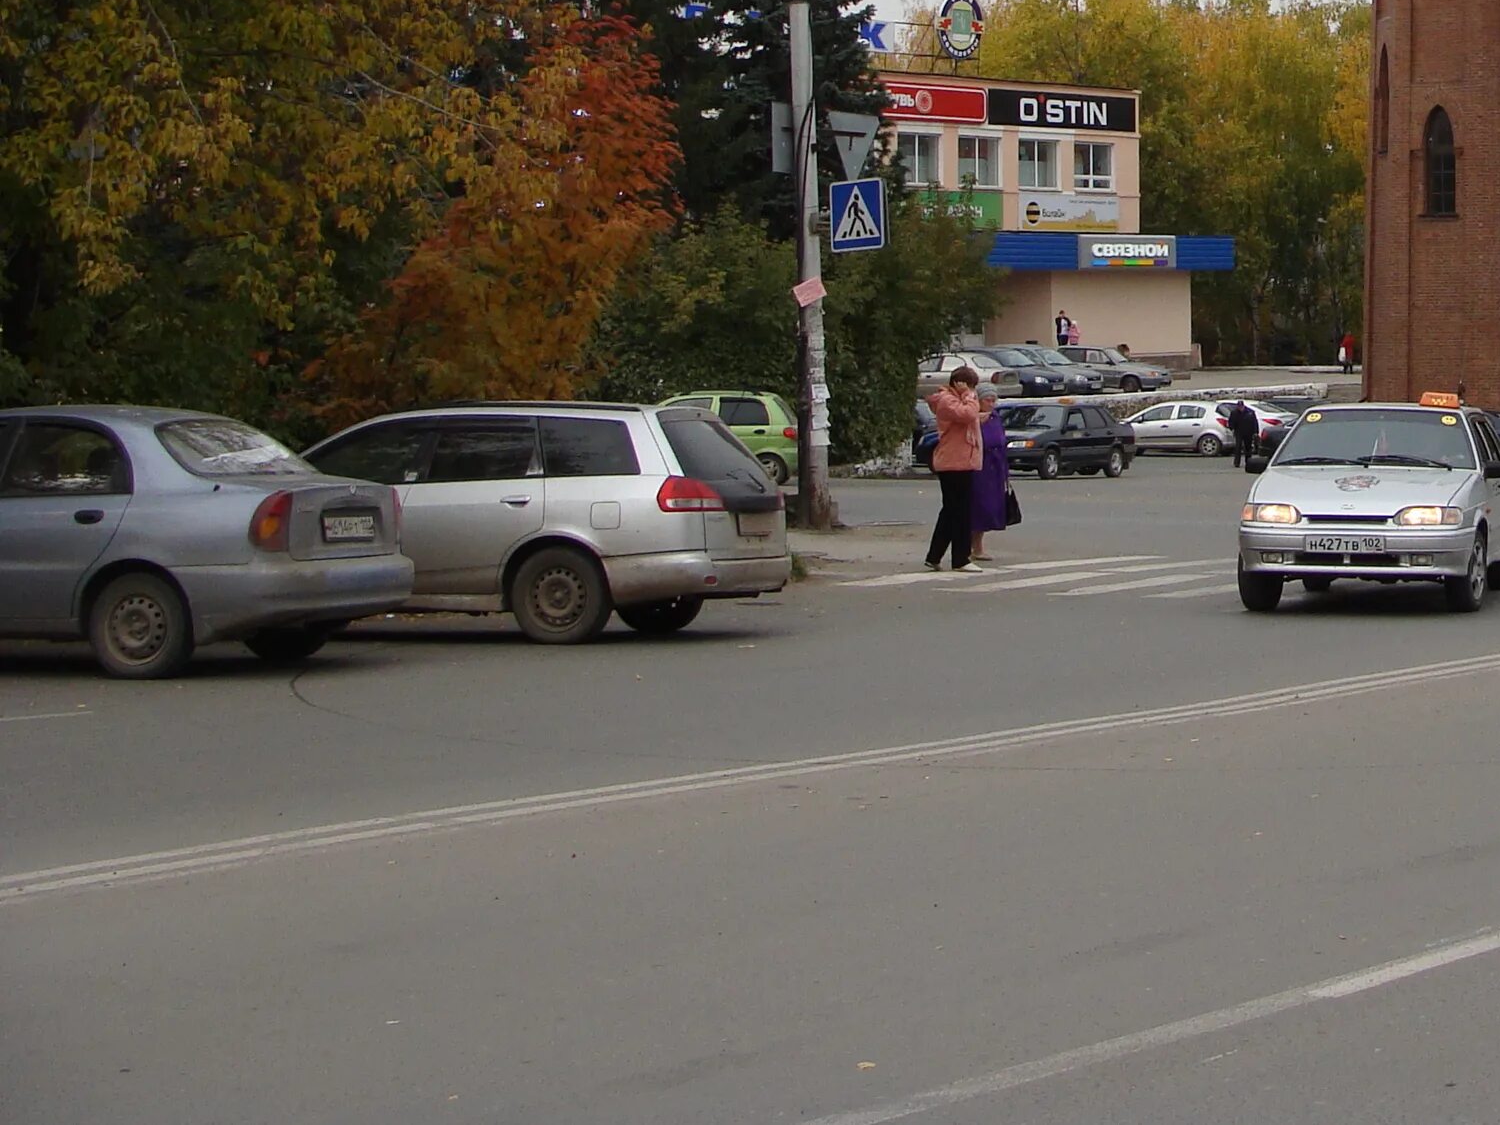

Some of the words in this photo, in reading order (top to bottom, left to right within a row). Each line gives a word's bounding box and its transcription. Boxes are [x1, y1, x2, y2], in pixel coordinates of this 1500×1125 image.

[1019, 94, 1108, 126] O'STIN
[1091, 241, 1169, 258] СВЯЗНОЙ
[1362, 537, 1381, 548] 102
